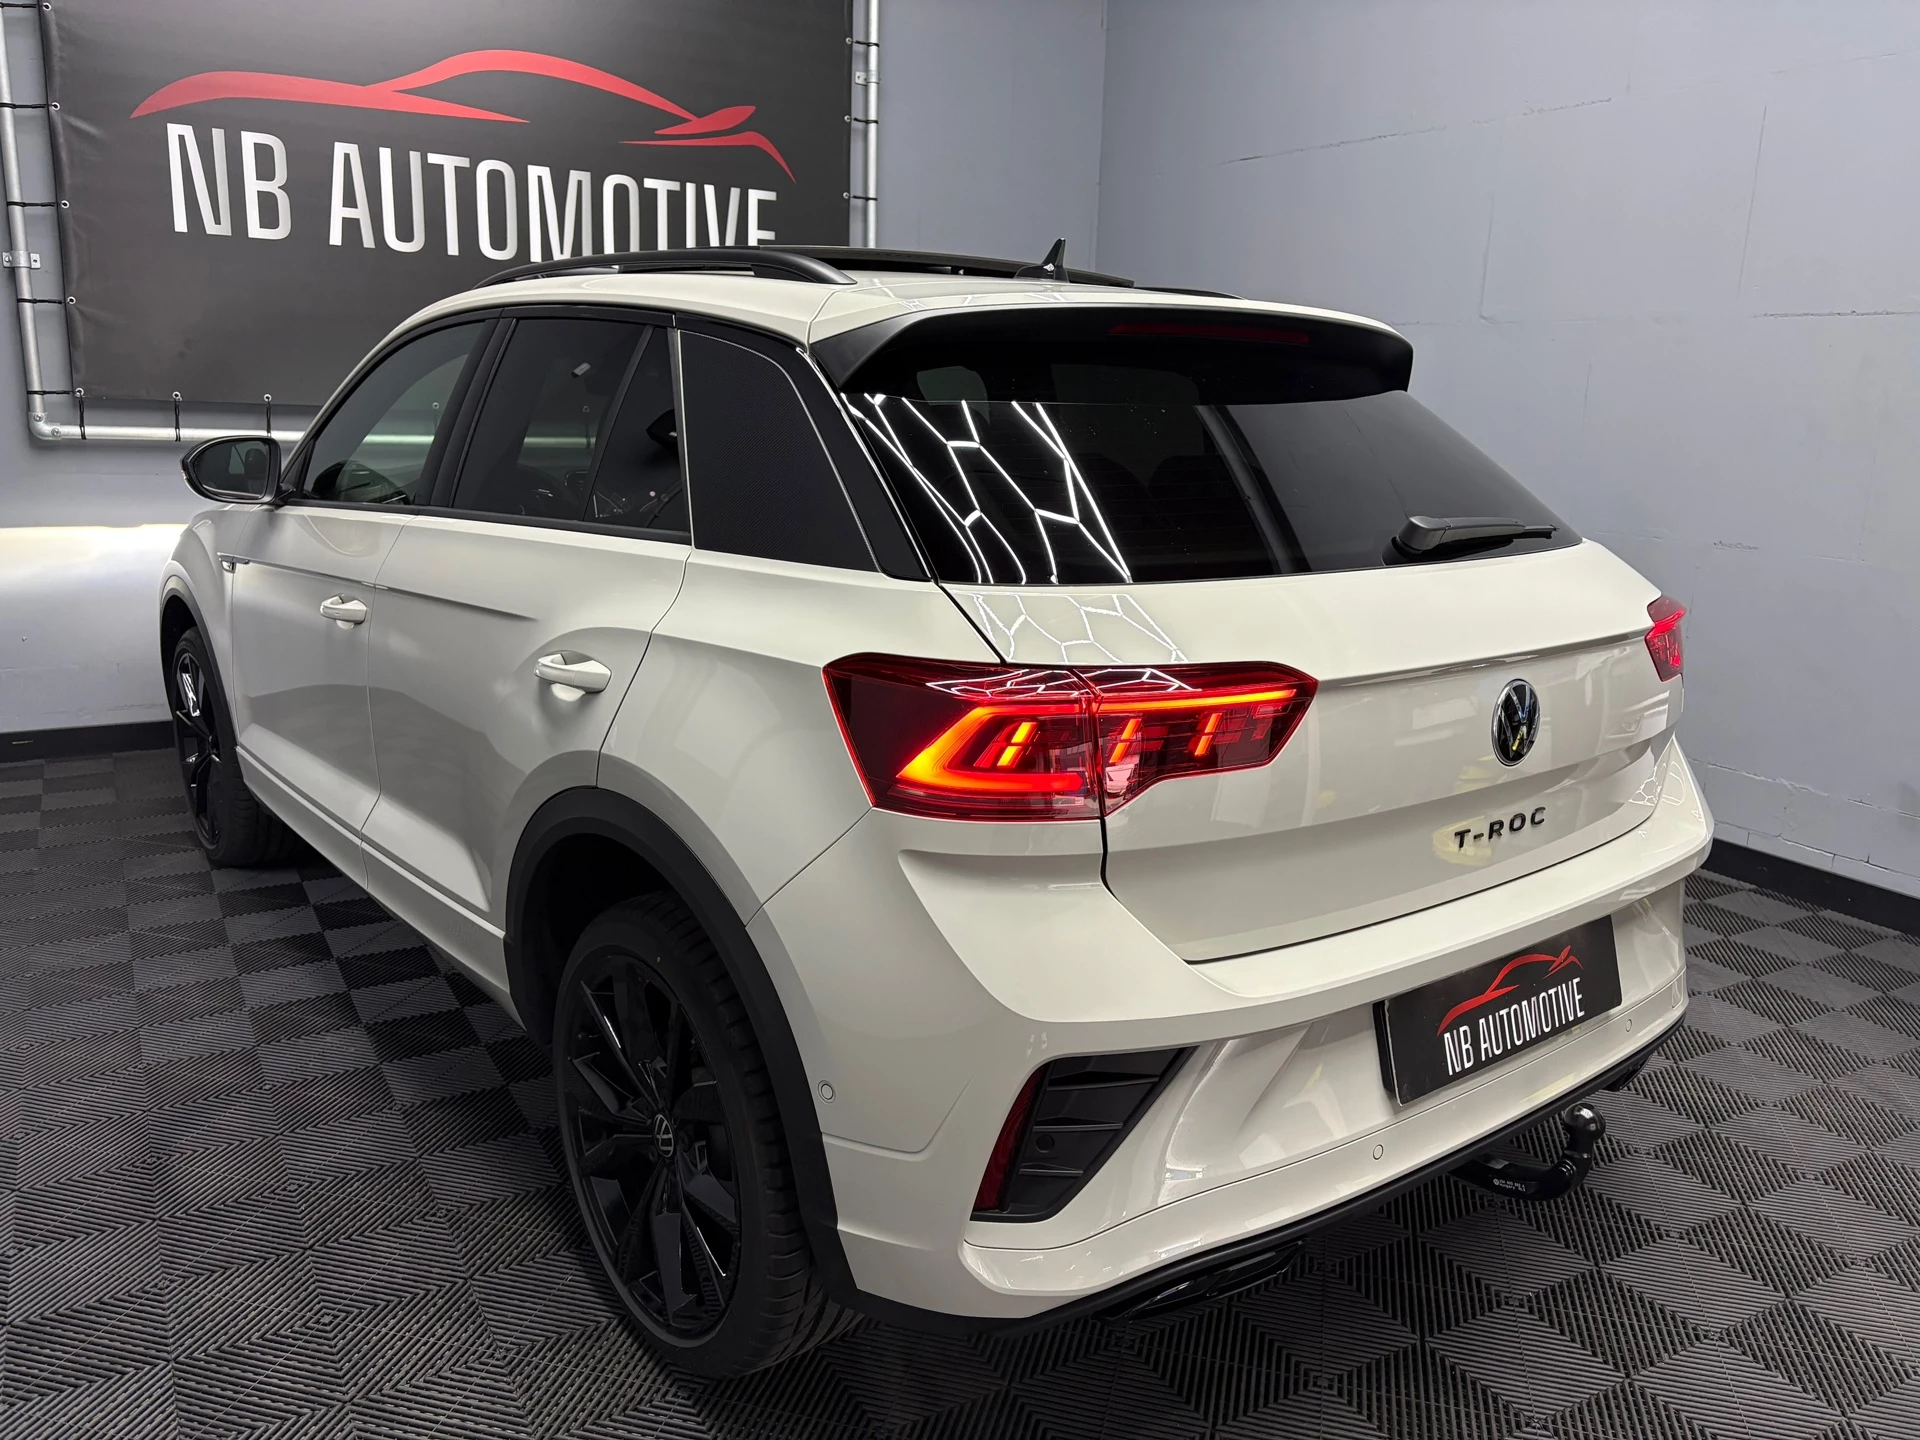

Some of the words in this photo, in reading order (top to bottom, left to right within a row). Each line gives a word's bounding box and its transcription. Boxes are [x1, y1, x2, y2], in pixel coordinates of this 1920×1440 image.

[166, 122, 292, 240] NB
[328, 141, 778, 263] AUTOMOTIVE
[1454, 807, 1546, 849] T-ROC
[1443, 1024, 1475, 1076] NB
[1478, 977, 1585, 1062] AUTOMOTIVE
